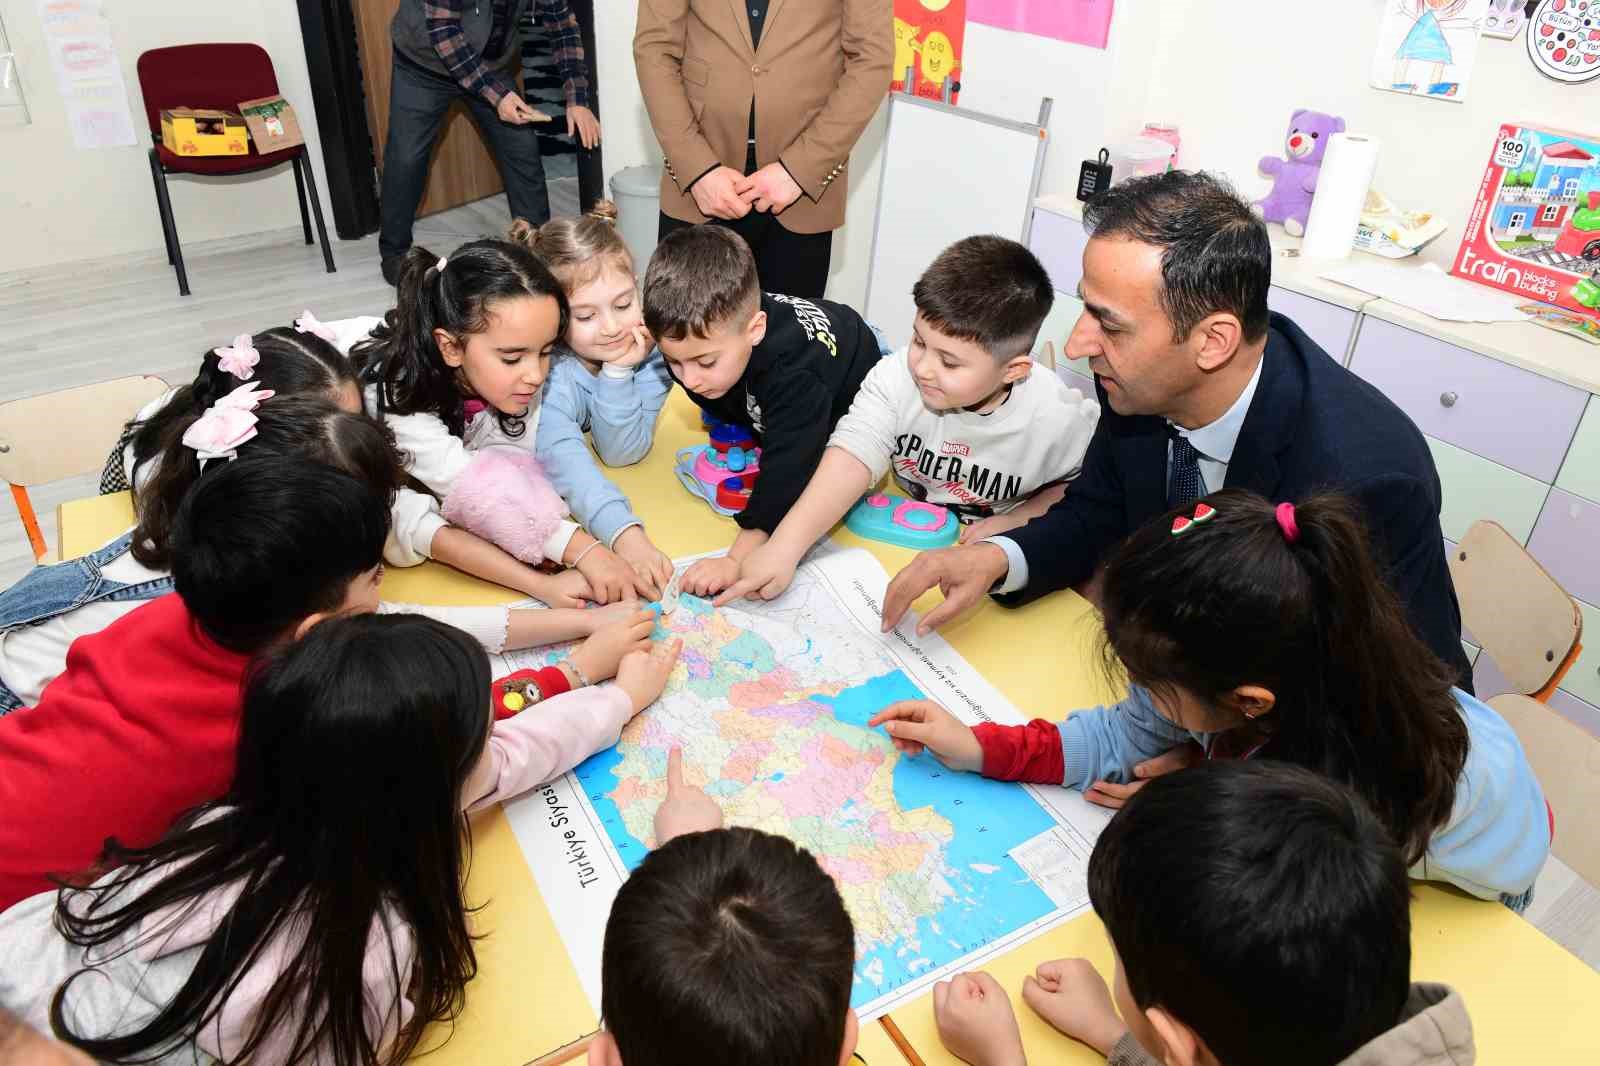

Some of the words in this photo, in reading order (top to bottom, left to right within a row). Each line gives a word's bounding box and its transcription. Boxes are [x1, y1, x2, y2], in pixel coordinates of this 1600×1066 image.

[1502, 141, 1523, 153] 100
[1081, 170, 1097, 196] JBL
[1460, 246, 1520, 288] train
[1520, 280, 1557, 301] building
[942, 441, 970, 456] MARVEL
[535, 784, 569, 828] Siyasi
[563, 829, 599, 888] Türkiye
